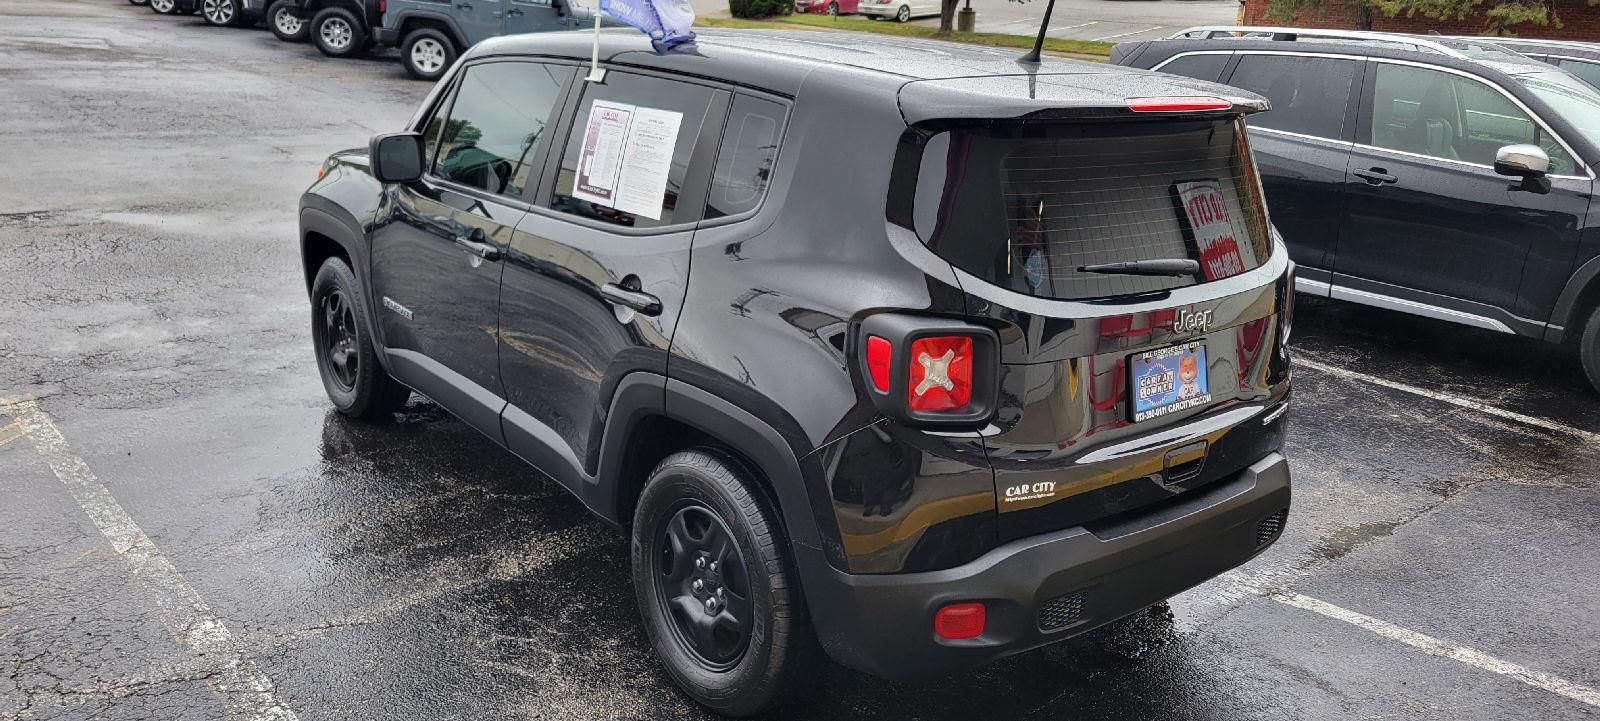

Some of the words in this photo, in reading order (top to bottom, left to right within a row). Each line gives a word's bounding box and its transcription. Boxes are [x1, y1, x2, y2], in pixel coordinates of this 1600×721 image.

[1173, 308, 1213, 334] Jeep
[1005, 484, 1030, 497] CAR
[1032, 481, 1057, 493] CITY
